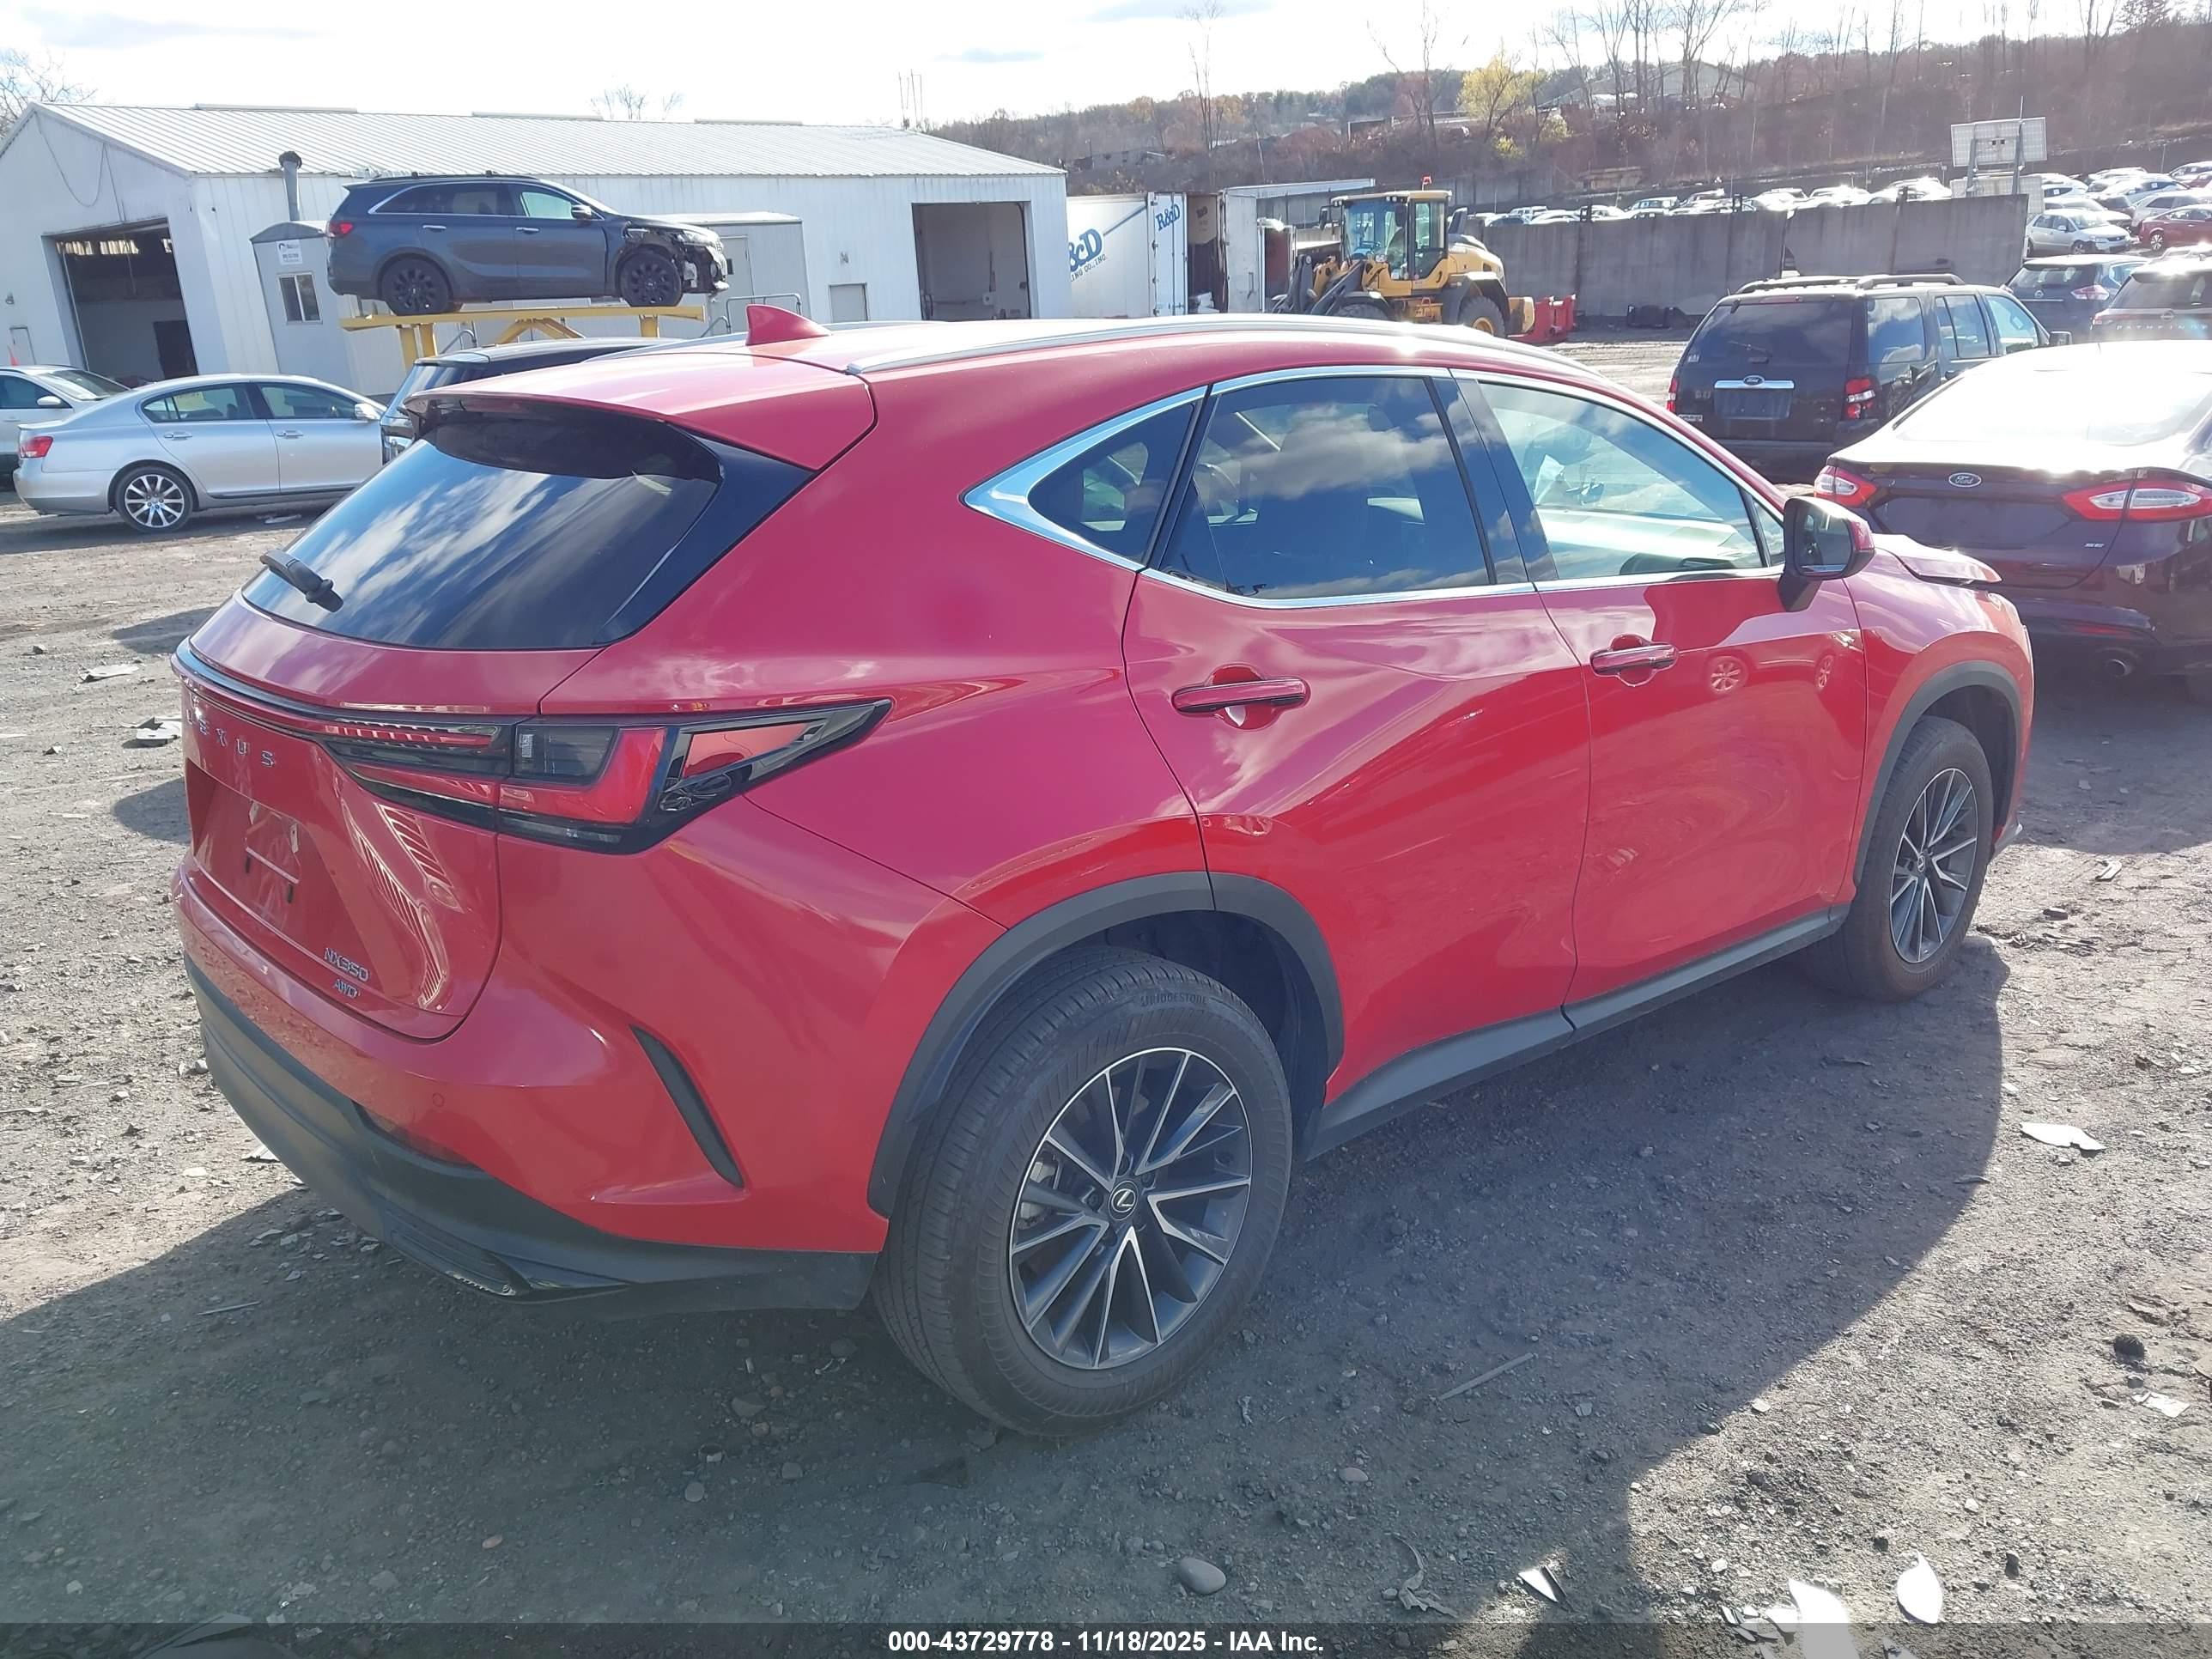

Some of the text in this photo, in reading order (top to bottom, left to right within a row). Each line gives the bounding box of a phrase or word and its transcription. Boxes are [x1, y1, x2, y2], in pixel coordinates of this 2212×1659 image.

[1155, 204, 1181, 231] R&D
[185, 708, 276, 768] LEXUS
[324, 947, 369, 982] NX350
[333, 978, 358, 999] AWD
[1140, 992, 1208, 1006] BRIDGESTONE
